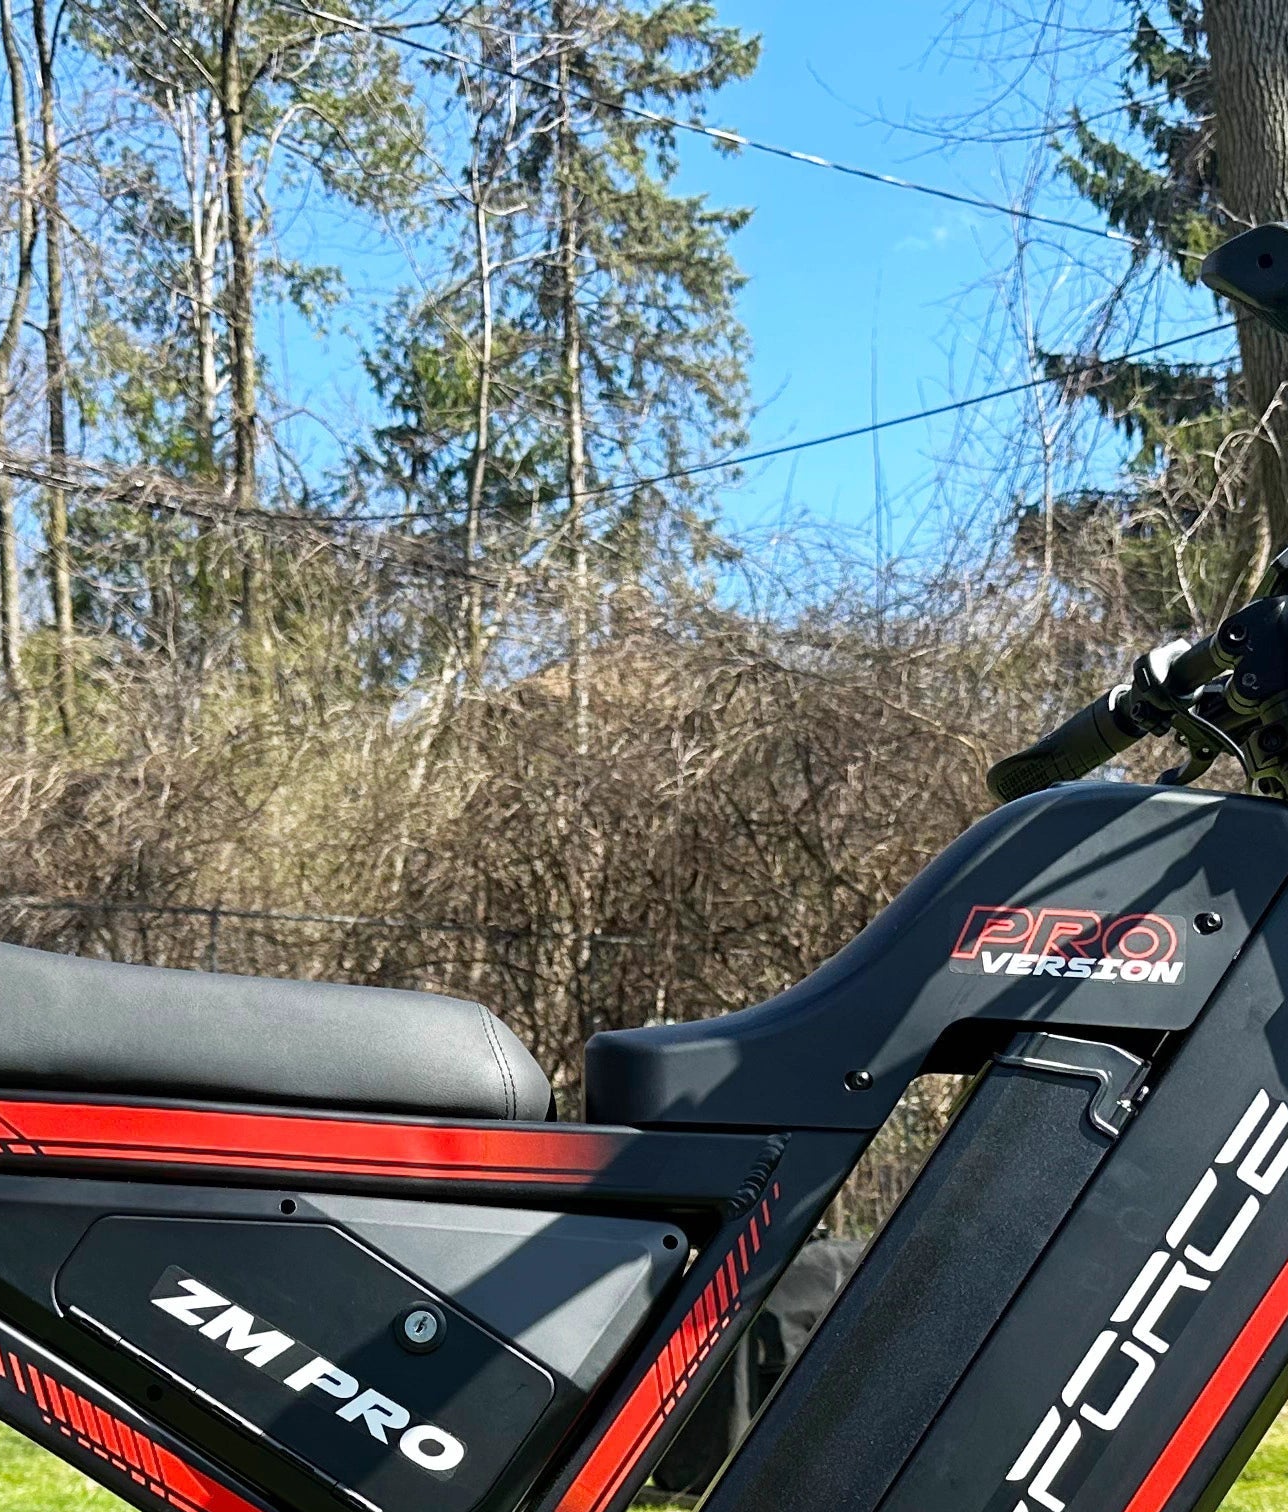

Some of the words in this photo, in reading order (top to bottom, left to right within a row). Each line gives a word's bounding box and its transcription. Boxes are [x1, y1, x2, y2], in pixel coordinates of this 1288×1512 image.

[950, 905, 1178, 962] PRO
[981, 951, 1183, 984] VERSION
[150, 1278, 296, 1368] ZM
[283, 1356, 465, 1471] PRO
